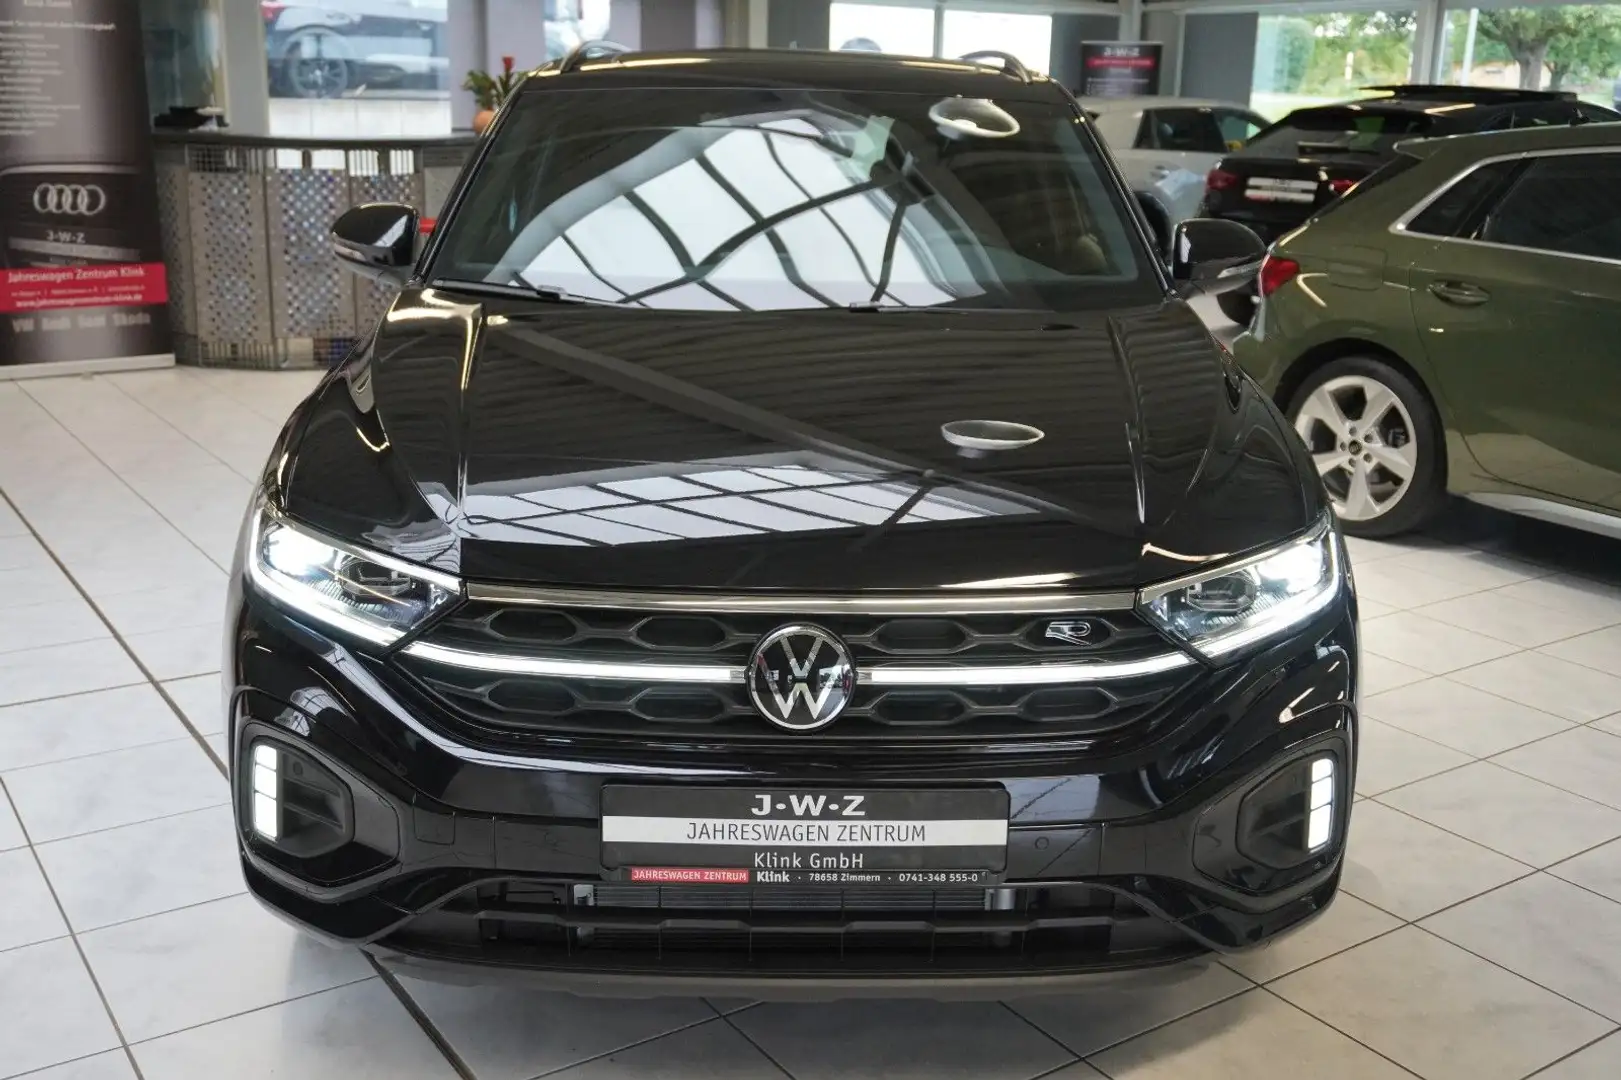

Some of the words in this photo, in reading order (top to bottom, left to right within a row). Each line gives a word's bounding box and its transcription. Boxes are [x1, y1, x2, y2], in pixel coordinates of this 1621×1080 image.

[8, 270, 73, 284] Jahreswagen
[76, 267, 118, 281] Zentrum
[120, 264, 145, 278] Klink
[687, 822, 829, 842] JAHRESWAGEN
[837, 824, 926, 842] ZENTRUM
[755, 852, 802, 868] Klink
[810, 853, 864, 869] GmbH
[633, 870, 700, 880] JAHRESWAGEN
[704, 871, 747, 881] ZENTRUM
[757, 870, 790, 883] Klink
[809, 872, 838, 882] 78658
[840, 872, 881, 882] Zimmern
[899, 873, 946, 882] 0741-348
[949, 873, 978, 882] 555-0
